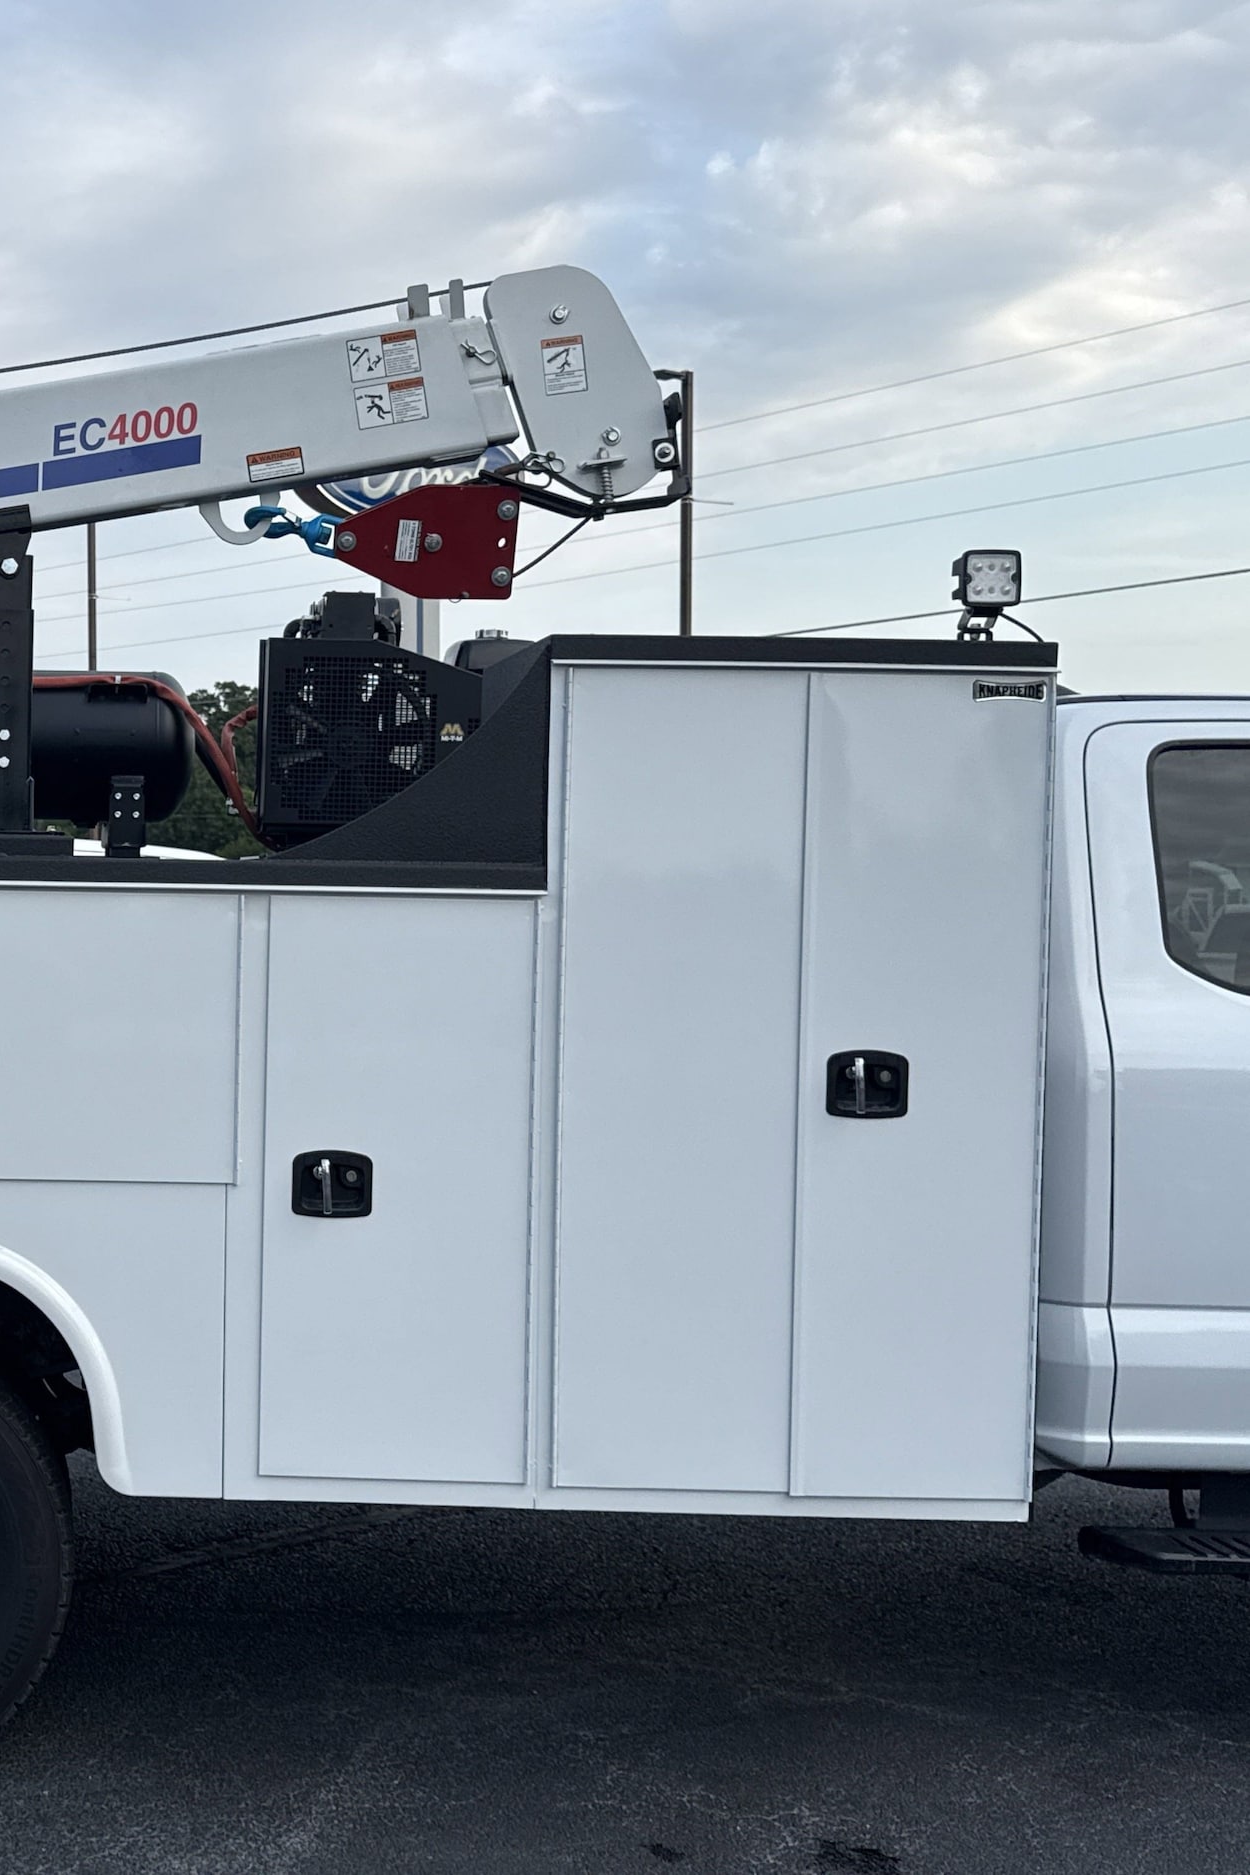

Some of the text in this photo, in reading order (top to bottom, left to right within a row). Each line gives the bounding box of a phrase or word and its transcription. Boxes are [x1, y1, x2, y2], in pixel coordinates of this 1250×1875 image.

[53, 402, 198, 456] EC4000
[259, 451, 296, 462] WARNING
[978, 683, 1044, 700] KNAPHEIDE
